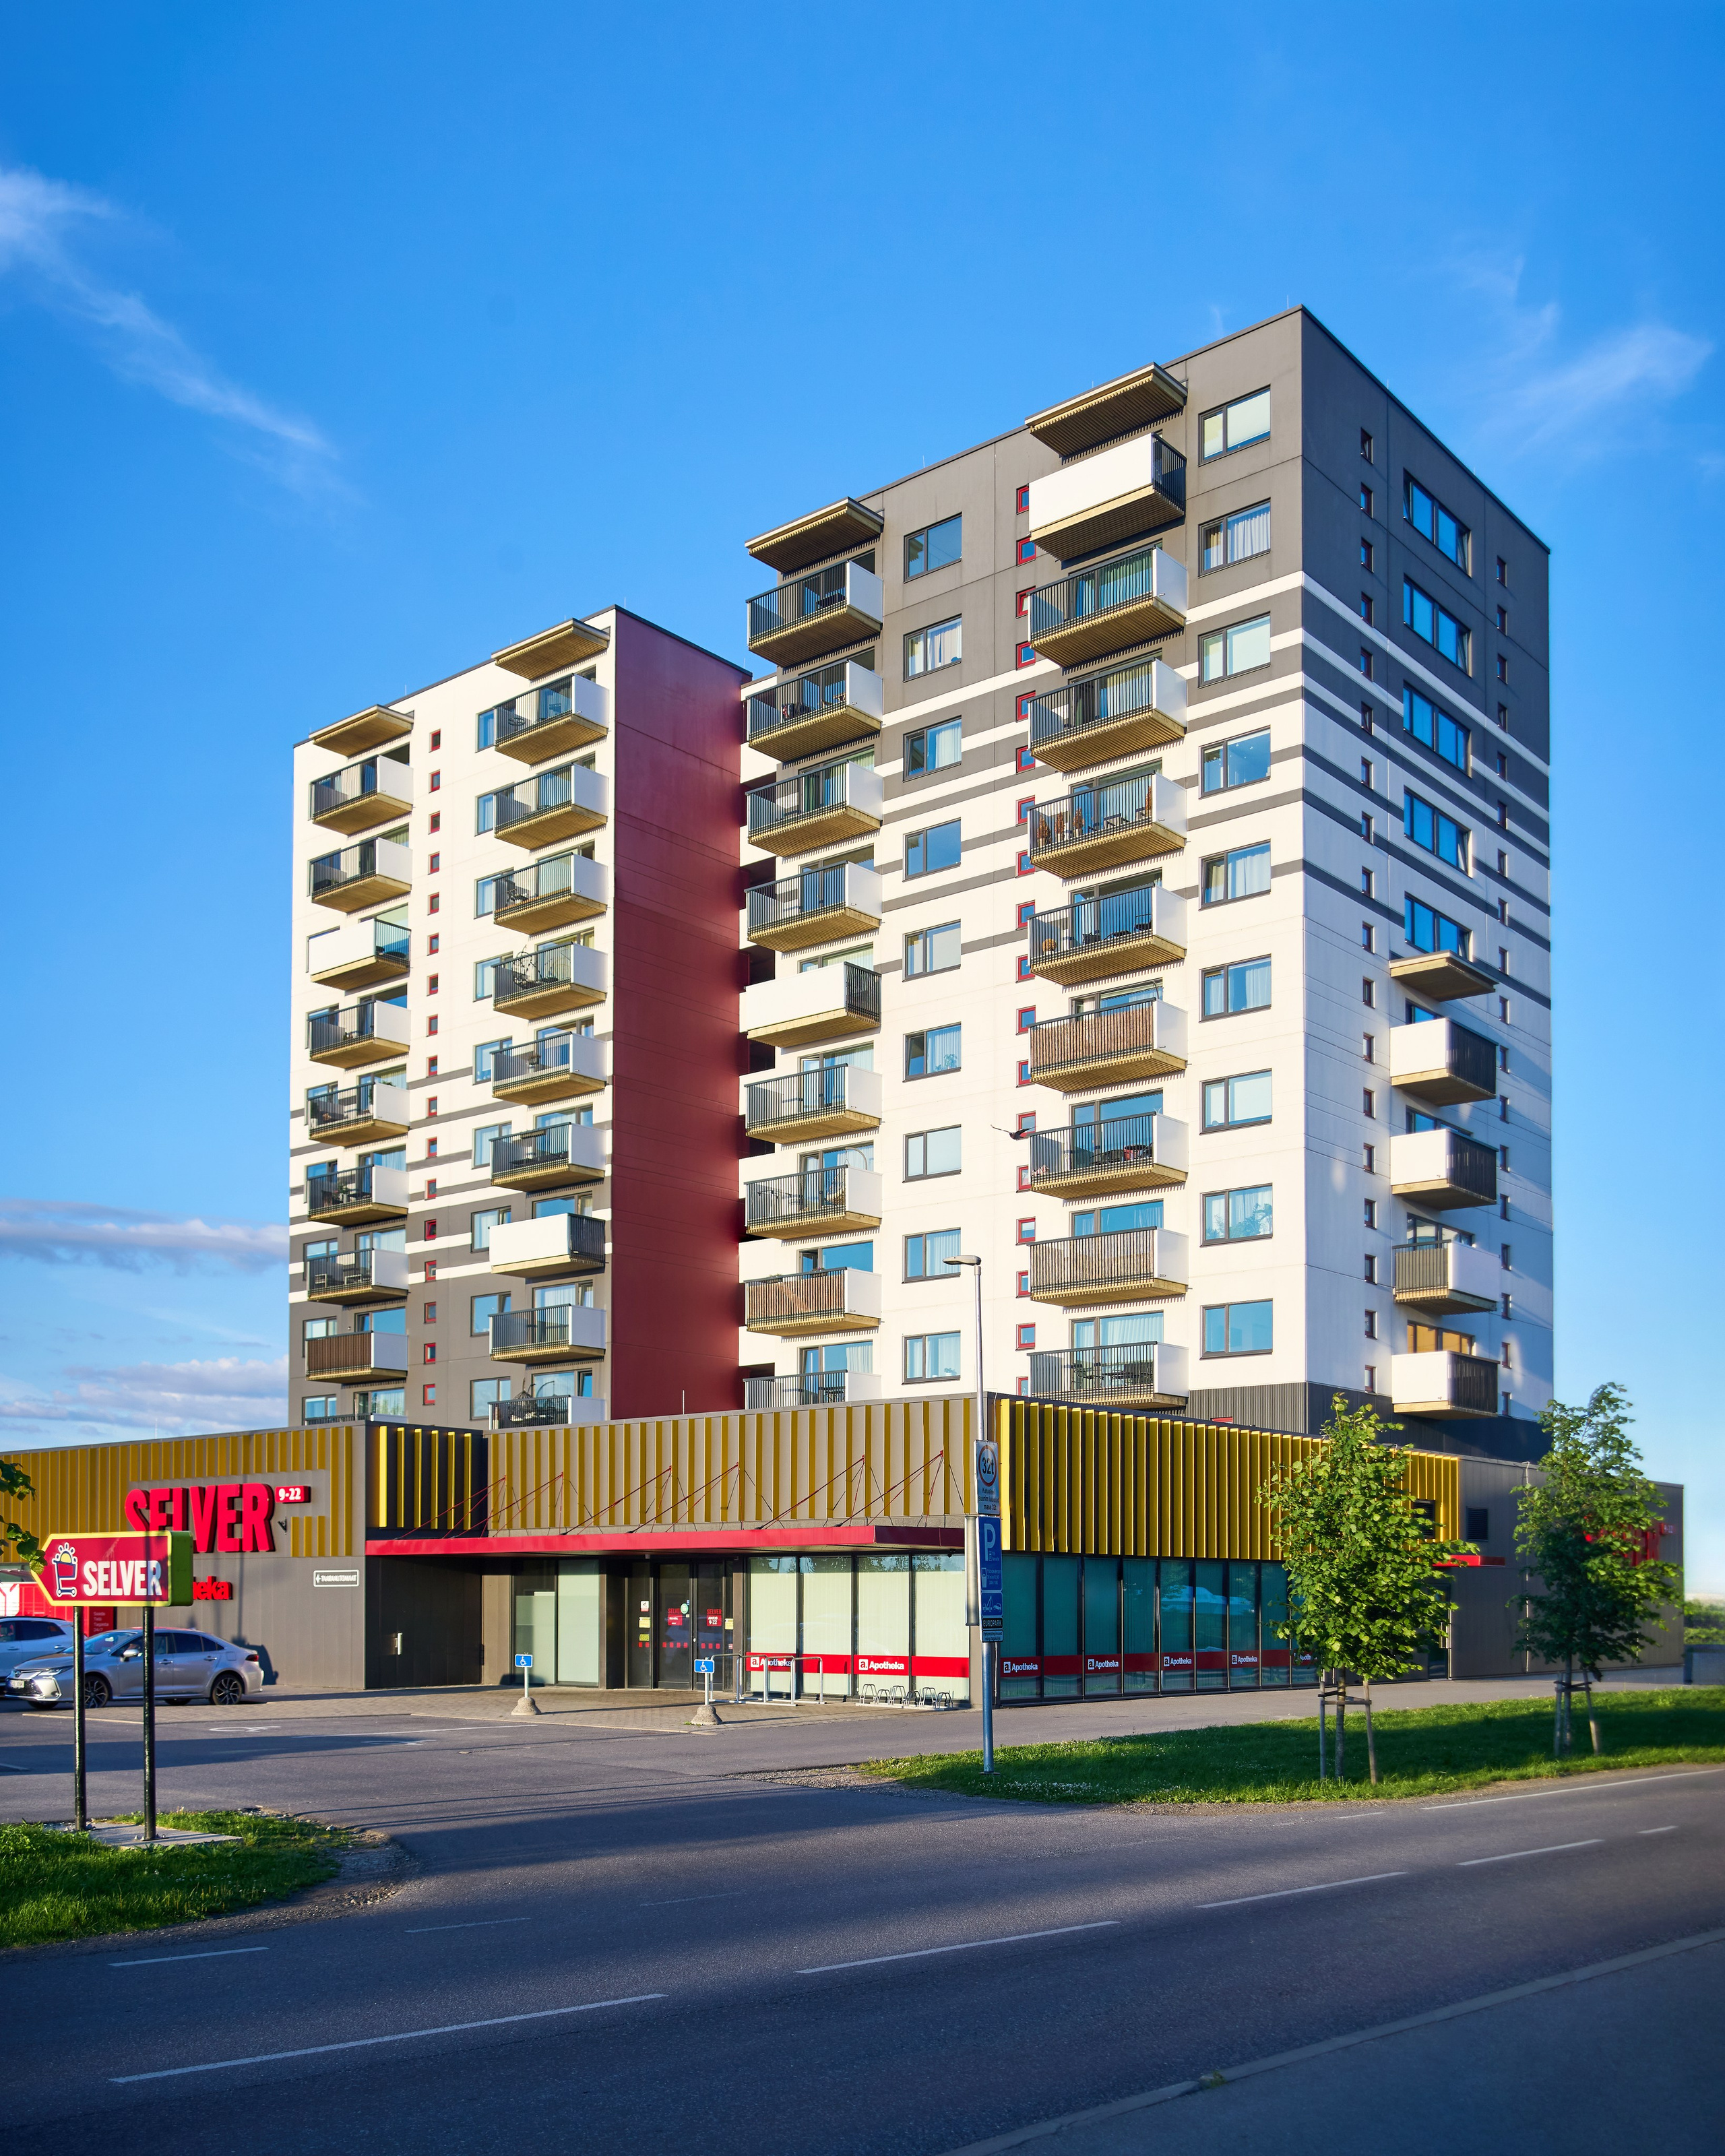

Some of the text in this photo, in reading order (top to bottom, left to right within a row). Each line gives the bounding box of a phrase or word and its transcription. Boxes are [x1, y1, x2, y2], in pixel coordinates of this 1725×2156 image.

[982, 1457, 994, 1475] 32t
[278, 1487, 301, 1500] 9-22
[984, 1523, 996, 1561] P
[83, 1560, 162, 1596] SELVER
[1095, 1660, 1119, 1670] Apotheka
[1170, 1657, 1192, 1666] Apotheka
[1238, 1656, 1257, 1664] Apotheka
[869, 1661, 904, 1670] Apotheka
[1011, 1663, 1038, 1672] Apotheka
